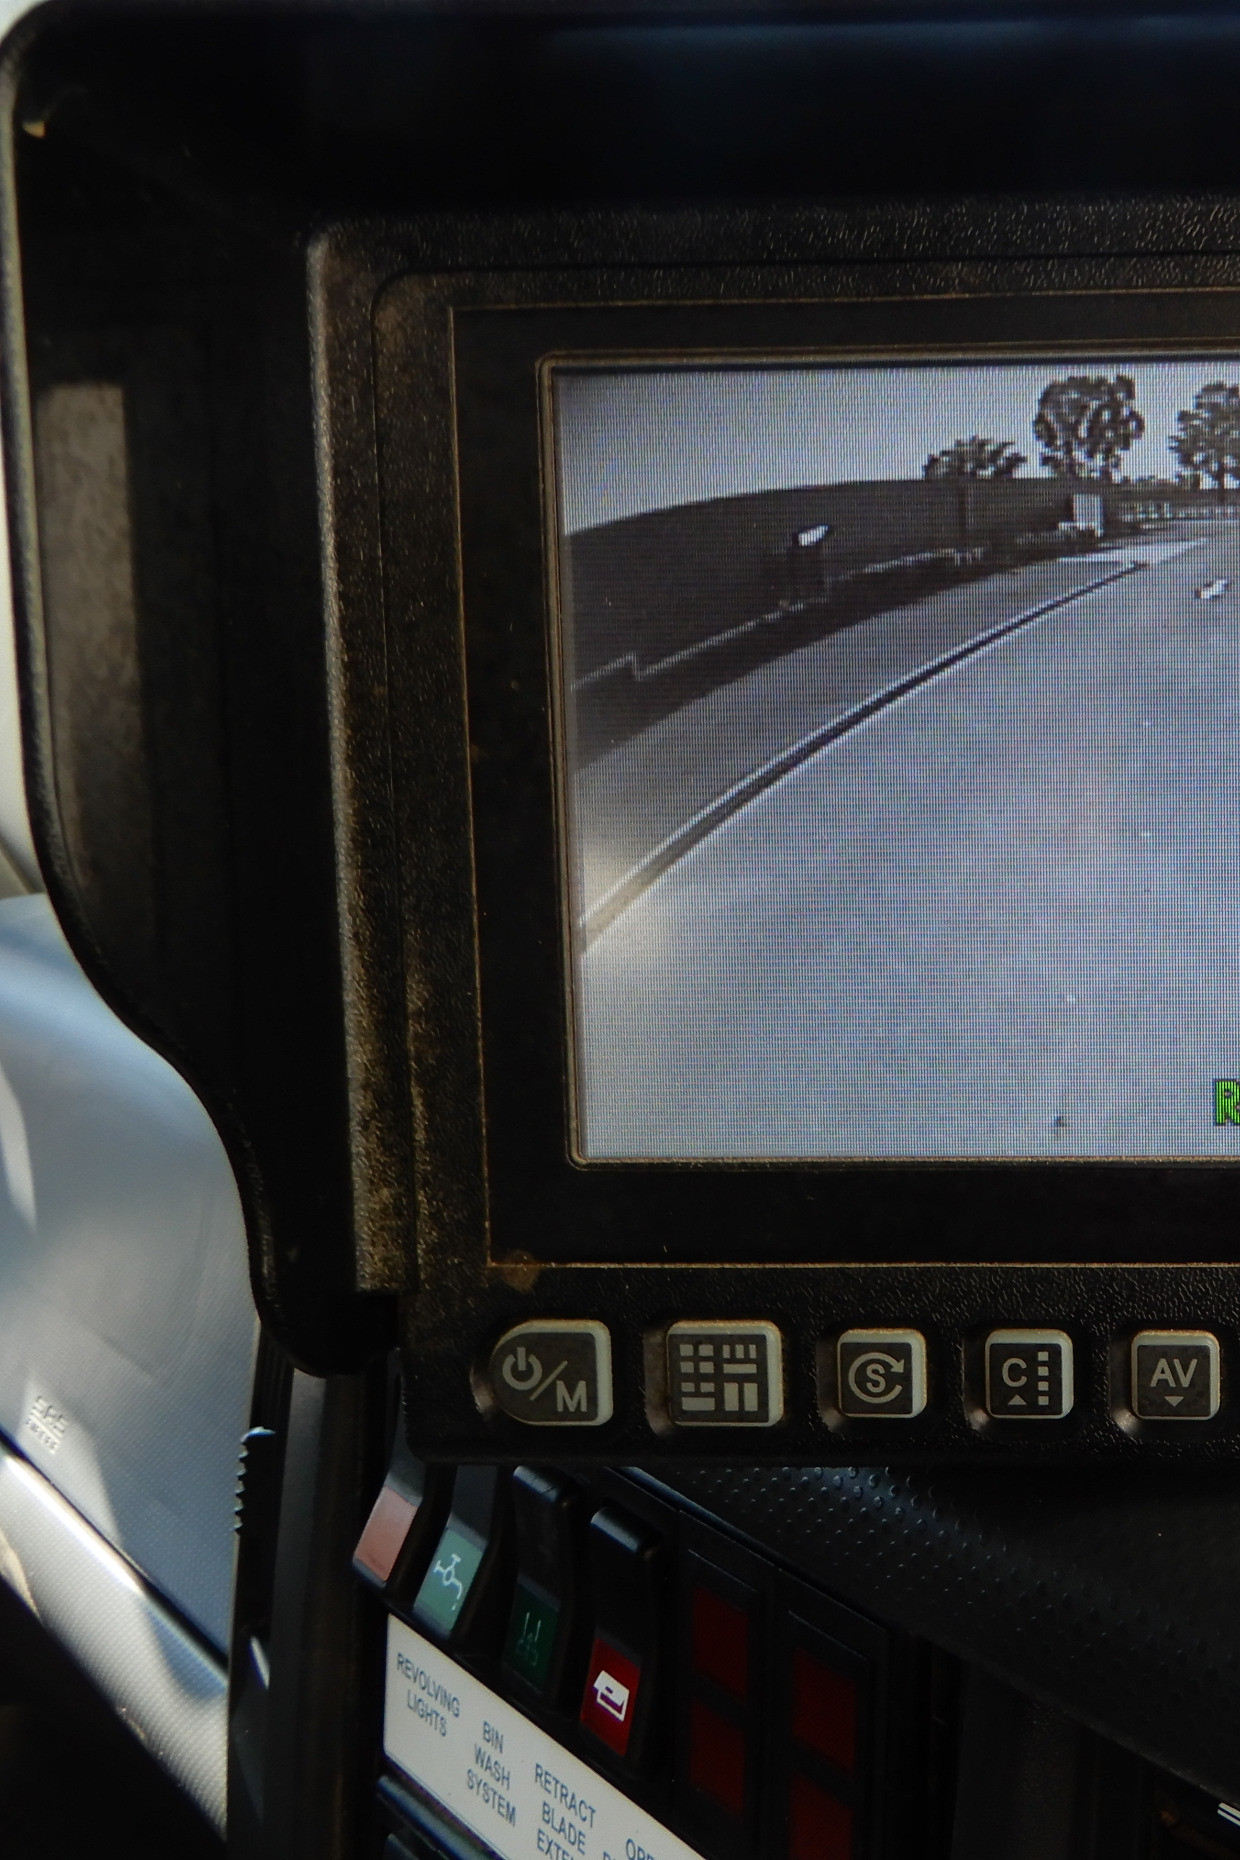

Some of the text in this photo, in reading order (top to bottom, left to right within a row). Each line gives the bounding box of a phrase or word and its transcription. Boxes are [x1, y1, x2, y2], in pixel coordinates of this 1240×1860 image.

[1149, 1357, 1198, 1388] AV
[396, 1652, 461, 1719] REVOLVING
[406, 1689, 447, 1738] LIGHTS
[482, 1720, 505, 1755] BIN
[474, 1743, 511, 1791] WASH
[466, 1768, 516, 1827] SYSTEM
[534, 1763, 597, 1829] RETRACT
[541, 1800, 587, 1856] BLADE
